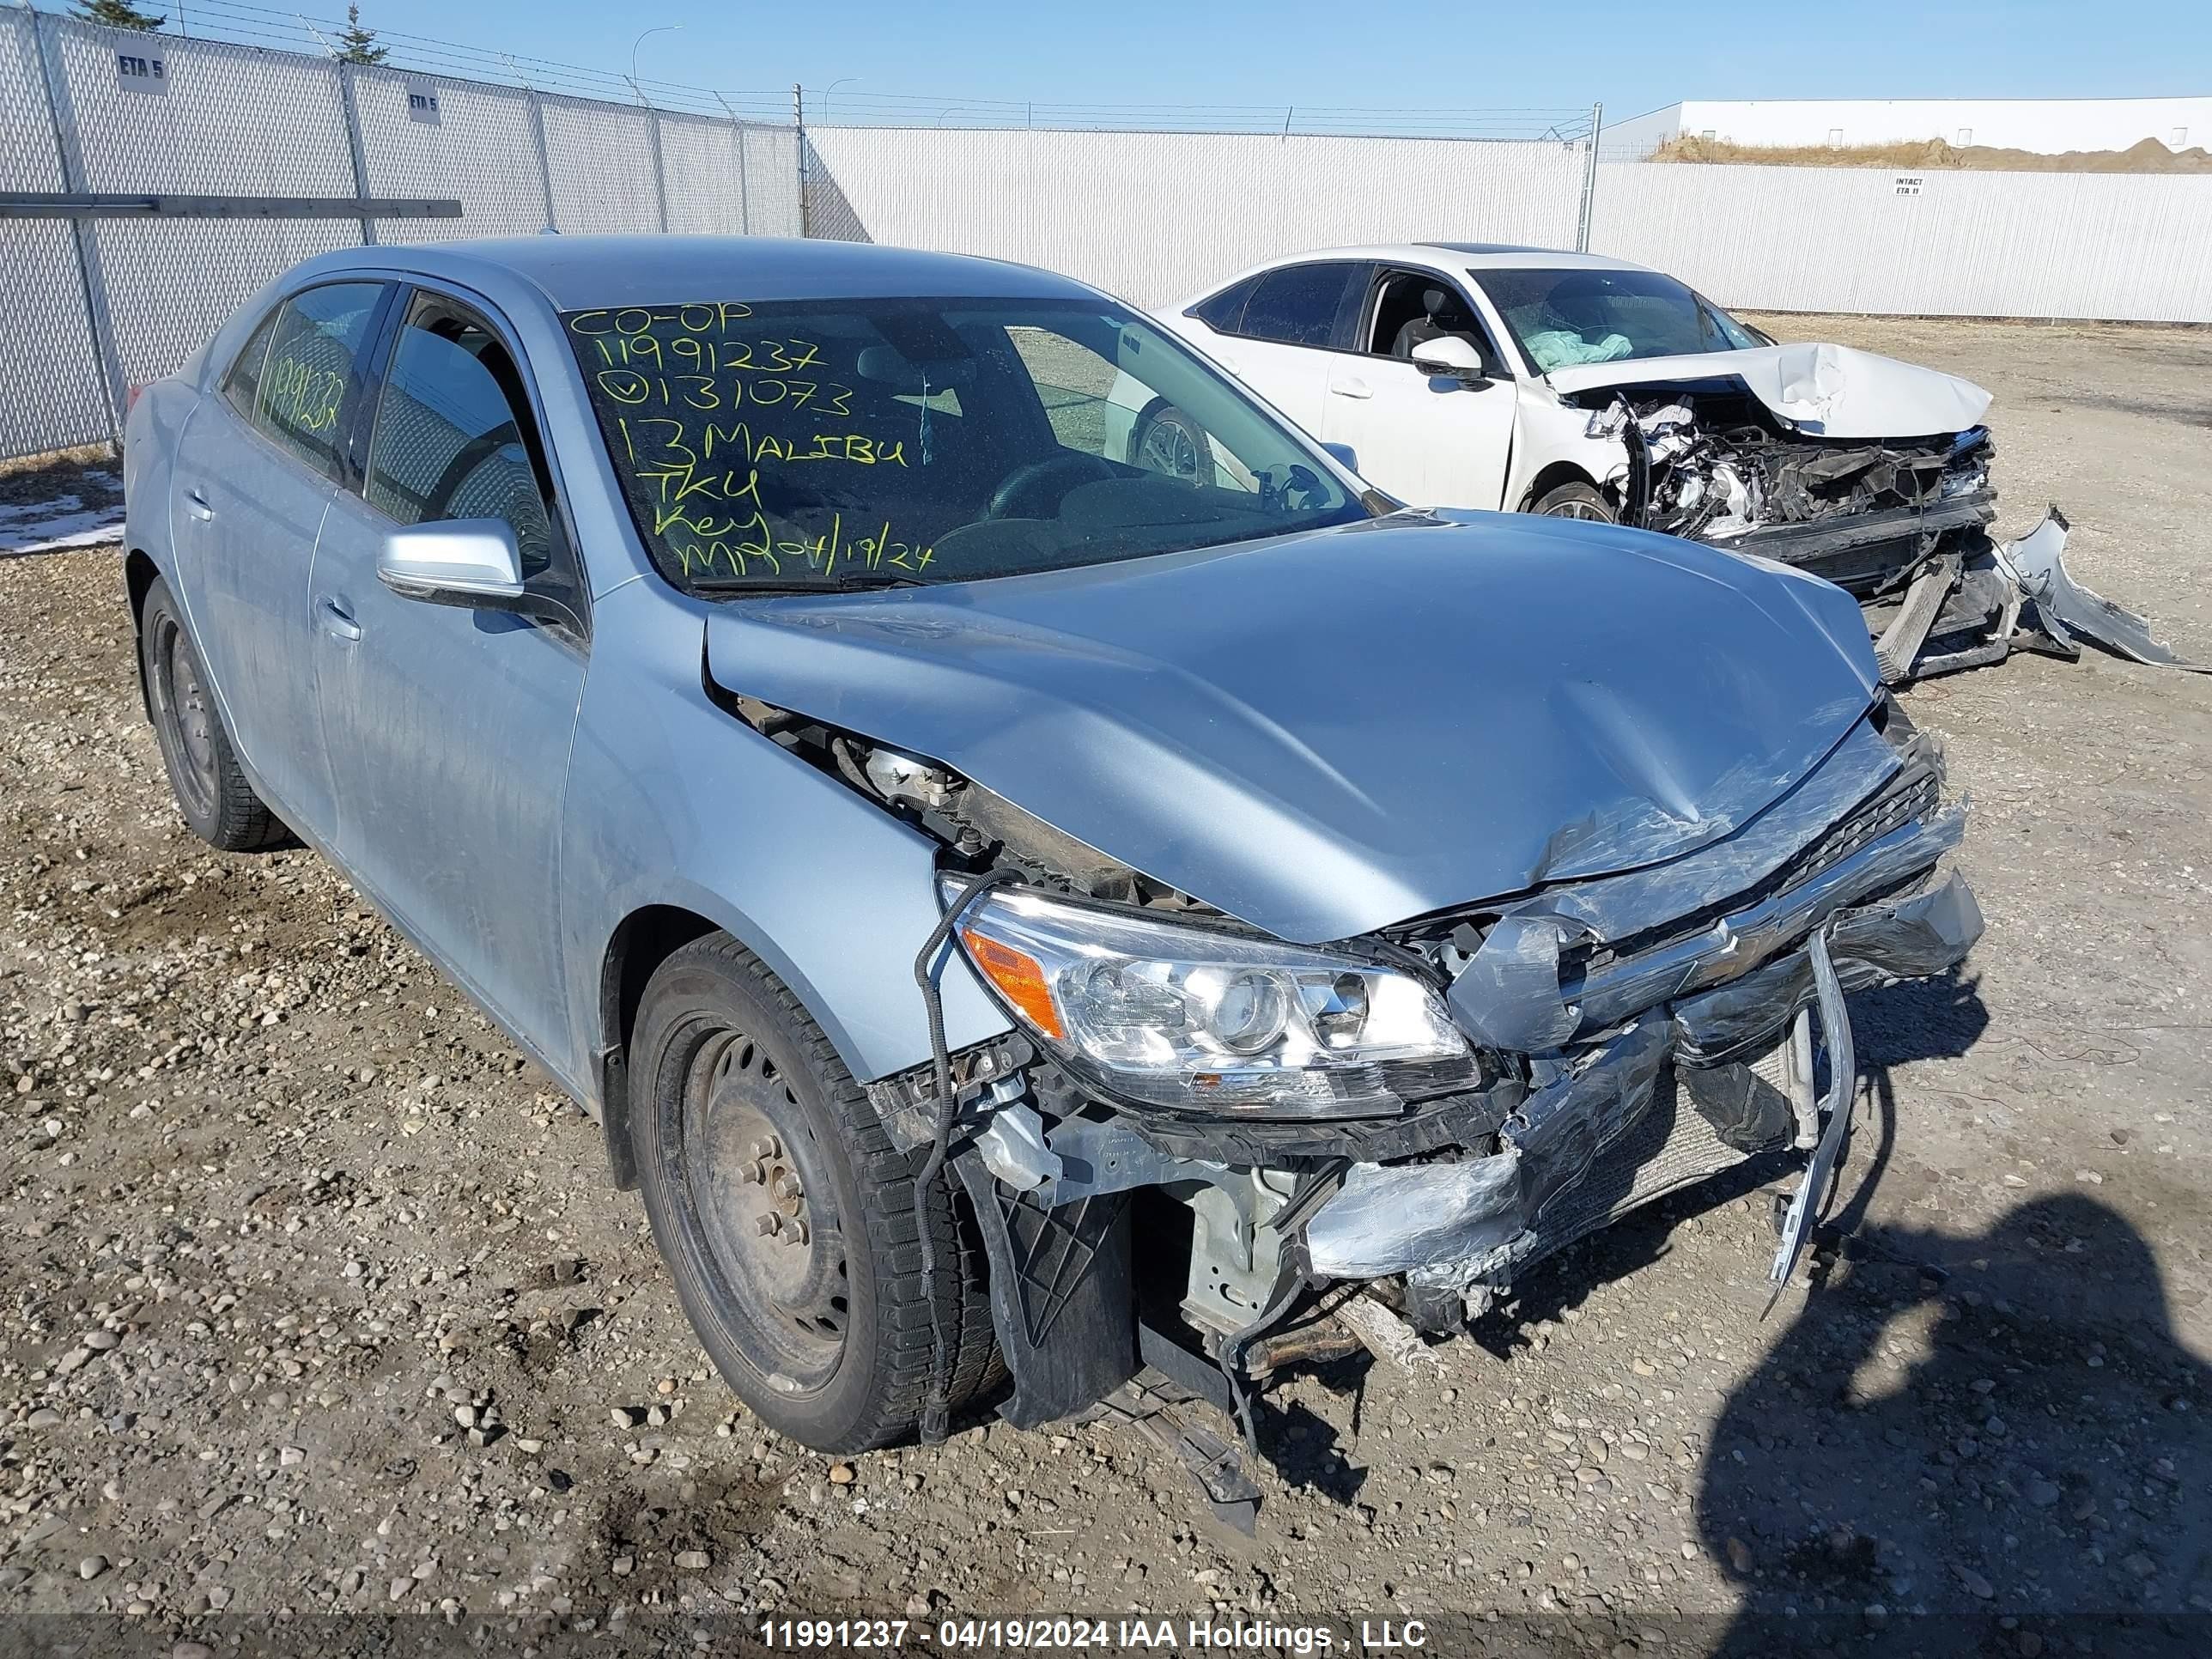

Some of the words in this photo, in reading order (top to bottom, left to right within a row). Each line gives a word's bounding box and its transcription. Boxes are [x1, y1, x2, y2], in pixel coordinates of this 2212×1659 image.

[118, 55, 149, 77] ETA
[152, 59, 164, 79] 5
[410, 94, 428, 111] ETA
[429, 97, 437, 112] 5
[571, 302, 753, 336] CO-OP
[596, 335, 830, 373] 11991237
[618, 418, 698, 469] 13
